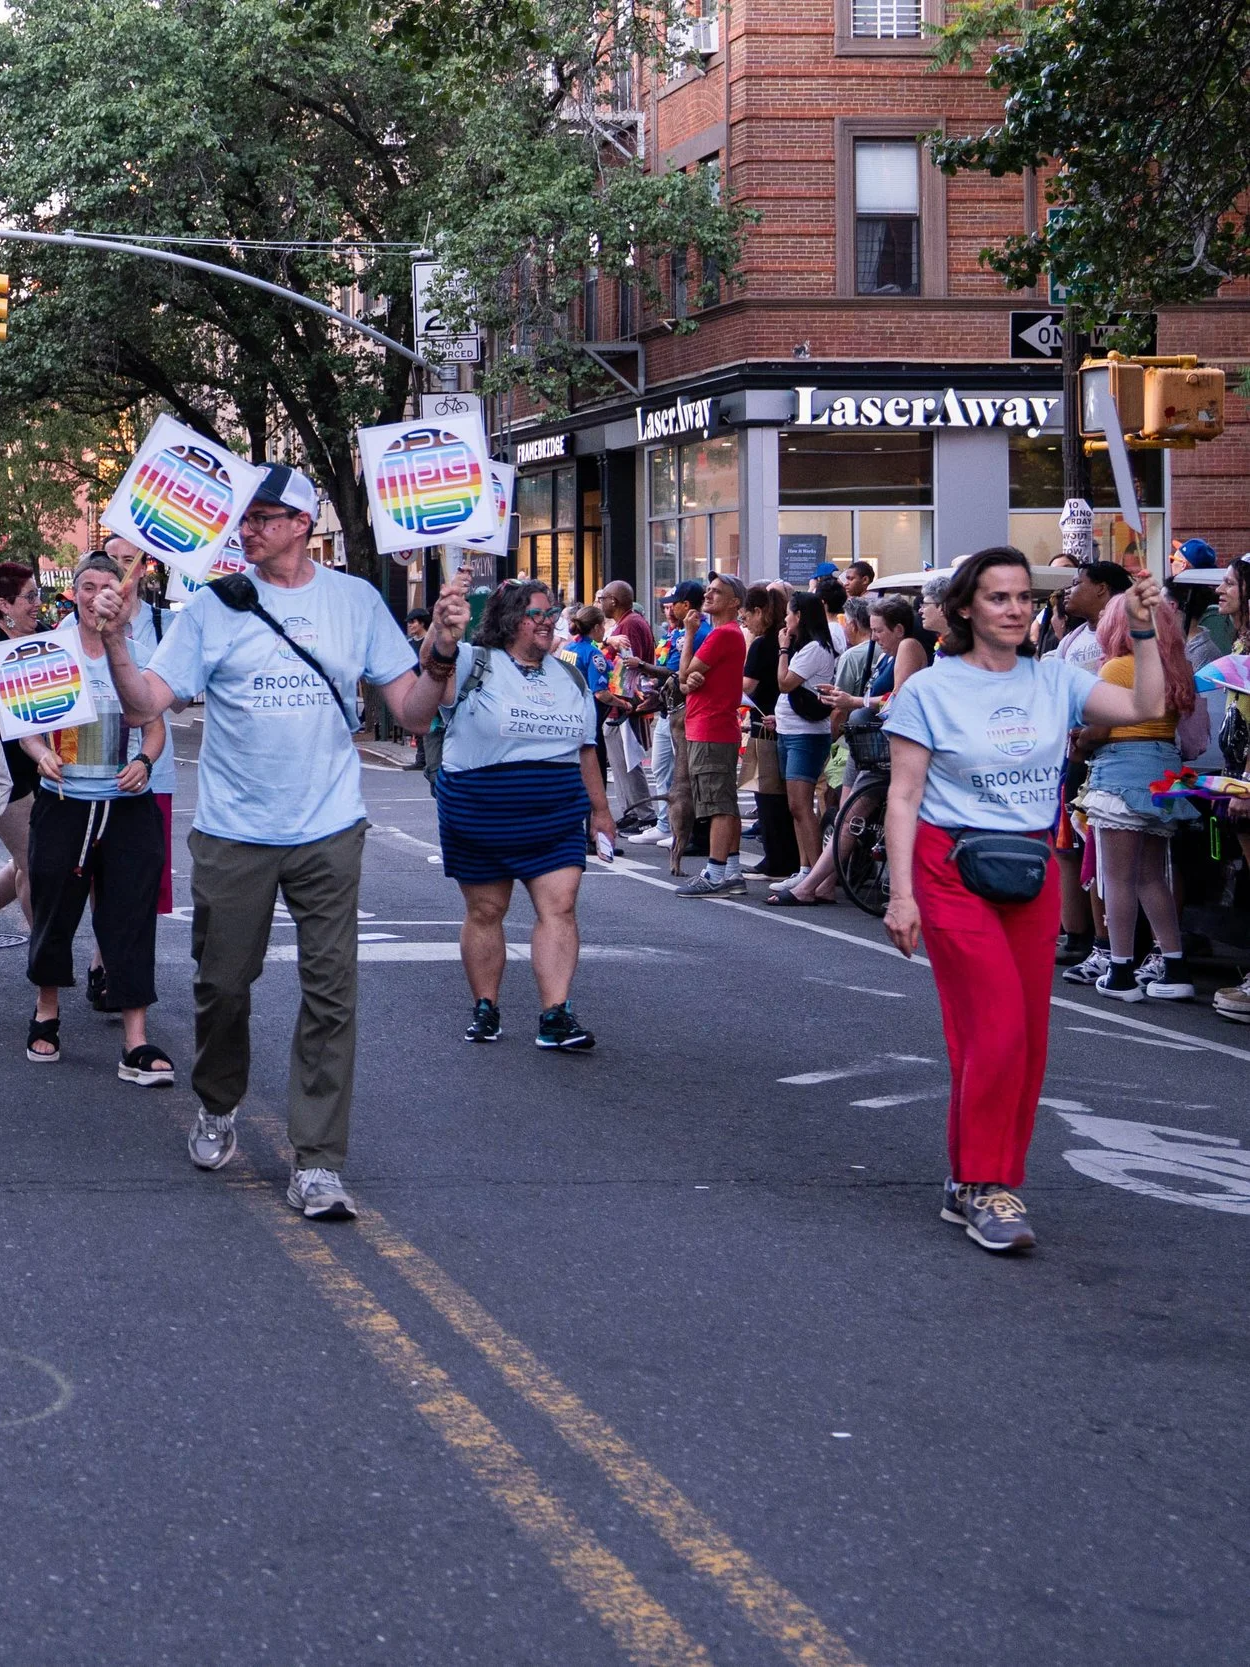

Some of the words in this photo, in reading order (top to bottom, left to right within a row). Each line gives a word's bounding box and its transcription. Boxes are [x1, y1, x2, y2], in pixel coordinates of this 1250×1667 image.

[1038, 326, 1064, 345] ON
[635, 396, 712, 441] LaserAway
[794, 386, 1060, 439] LaserAway
[516, 434, 565, 463] FRAMEBRIDGE
[253, 673, 335, 690] BROOKL
[252, 695, 282, 708] ZEN
[510, 708, 584, 724] BROOKLYN
[509, 721, 535, 733] ZEN
[537, 724, 584, 738] CENTER
[971, 766, 1061, 788] BROOKLYN
[976, 791, 1008, 804] ZEN
[1010, 787, 1056, 804] CENTE
